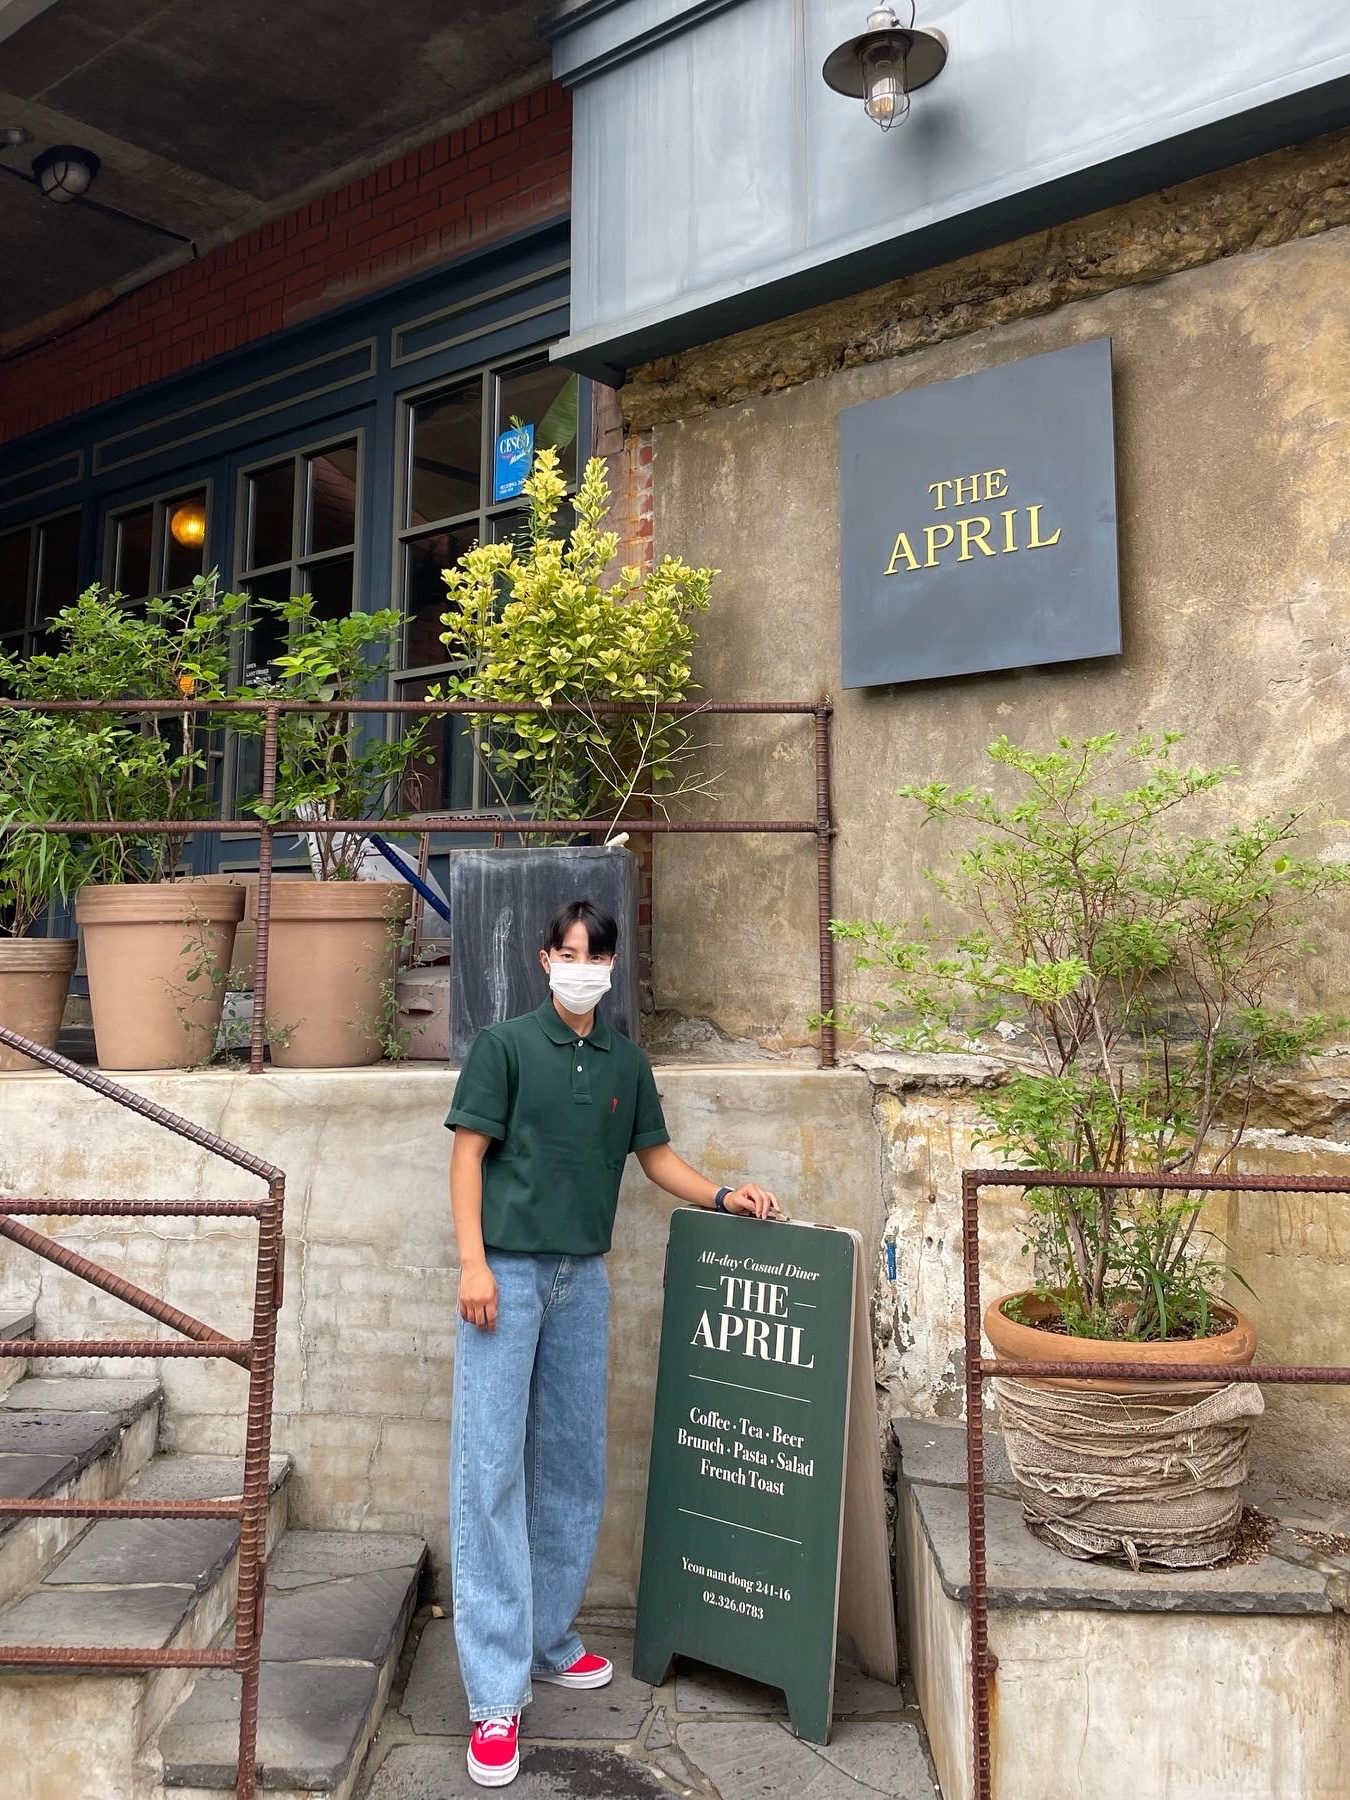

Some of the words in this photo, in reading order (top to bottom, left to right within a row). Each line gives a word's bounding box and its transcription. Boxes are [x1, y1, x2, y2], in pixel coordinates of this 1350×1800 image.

[927, 466, 1010, 511] THE
[883, 504, 1062, 576] APRIL
[697, 1250, 742, 1271] All-day
[743, 1257, 783, 1276] Casual
[785, 1263, 820, 1281] Diner
[719, 1275, 789, 1318] THE
[689, 1308, 815, 1369] APRIL
[689, 1406, 731, 1431] Coffee
[739, 1417, 763, 1439] Tea
[772, 1425, 805, 1449] Beer
[677, 1427, 725, 1455] Brunch
[733, 1441, 768, 1466] Pasta
[776, 1452, 814, 1477] Salad
[700, 1458, 746, 1486] French
[748, 1470, 786, 1496] Toast
[682, 1556, 705, 1576] Yeon
[706, 1567, 728, 1583] nam
[728, 1571, 754, 1593] dong
[755, 1580, 791, 1601] 241-16
[702, 1590, 764, 1620] 02.326.0783
